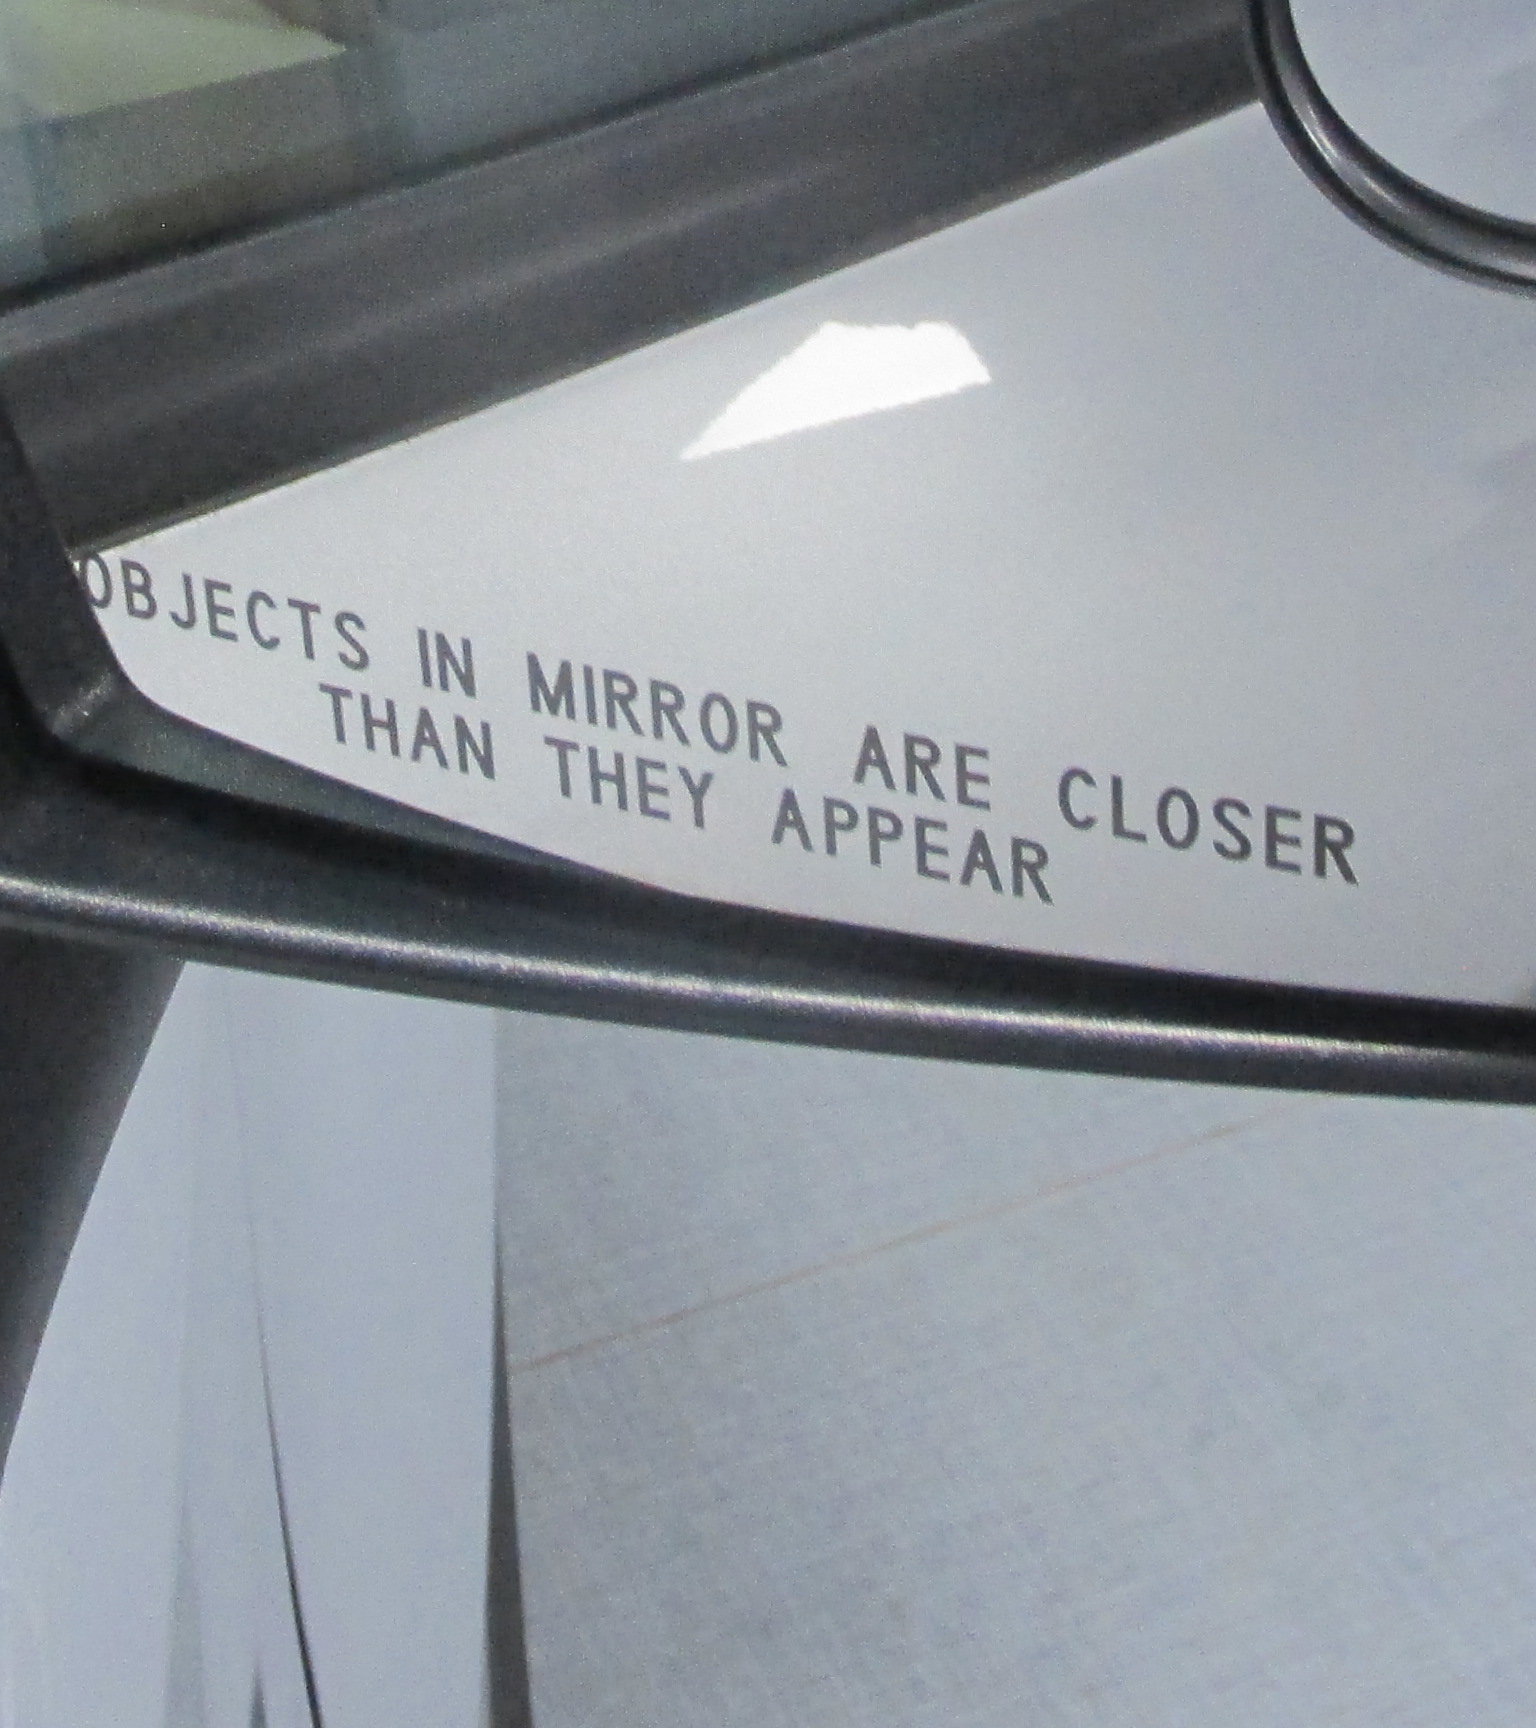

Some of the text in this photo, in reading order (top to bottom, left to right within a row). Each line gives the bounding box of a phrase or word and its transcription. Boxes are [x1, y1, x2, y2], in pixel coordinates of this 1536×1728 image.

[79, 551, 1360, 887] OBJECTS IN MIRROR ARE CLOSER
[317, 681, 1054, 906] THAN THEY APPEAR
